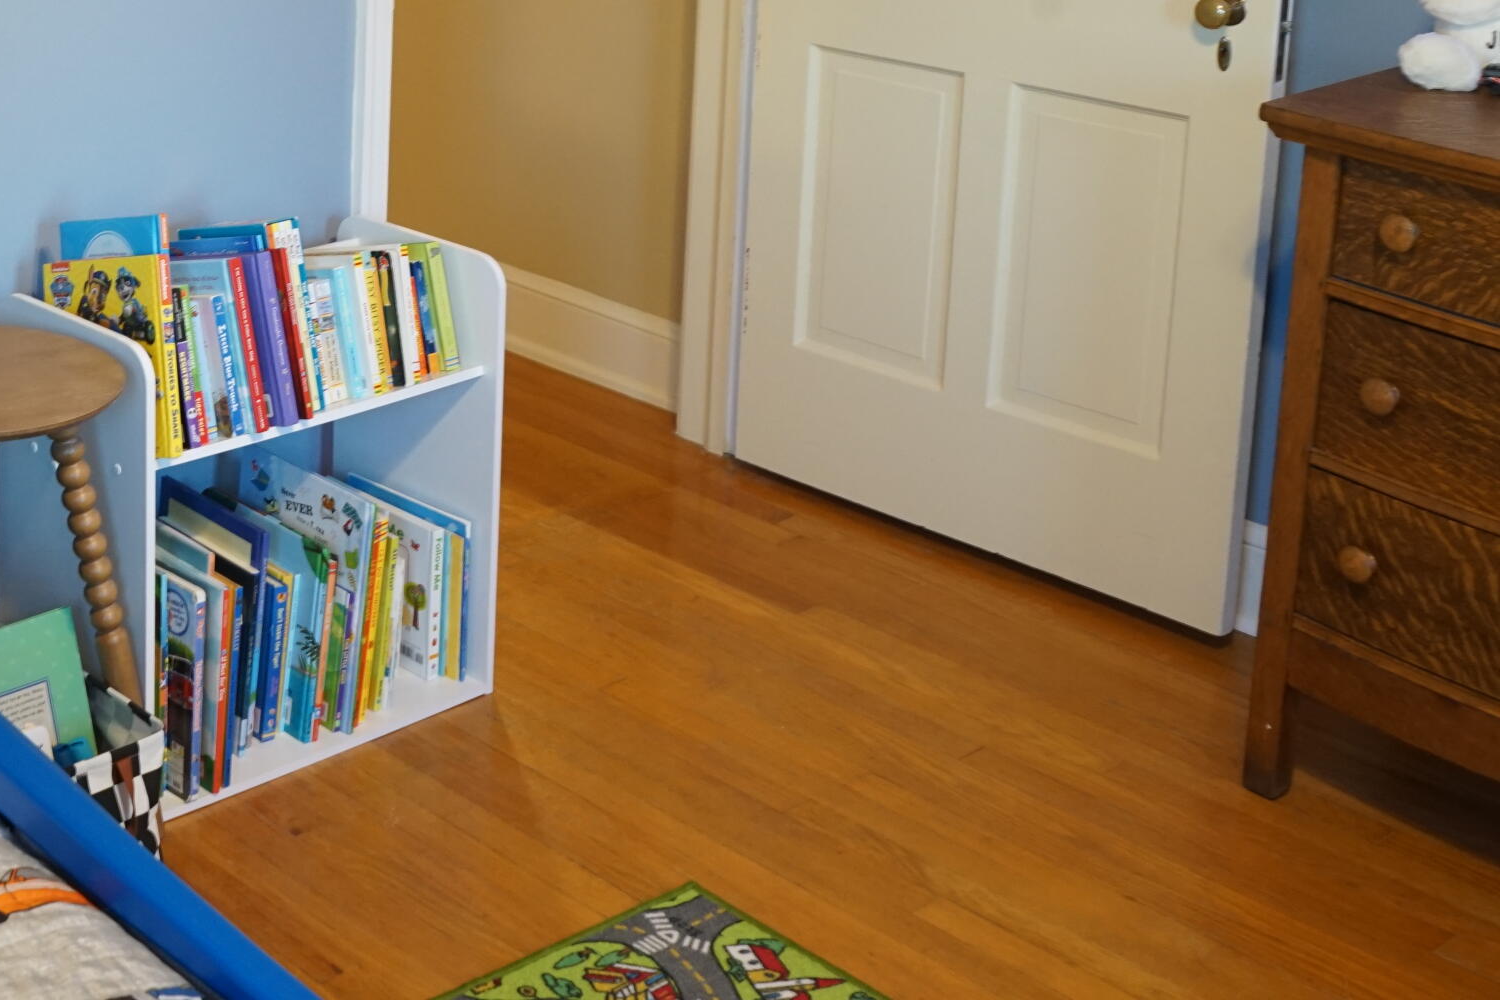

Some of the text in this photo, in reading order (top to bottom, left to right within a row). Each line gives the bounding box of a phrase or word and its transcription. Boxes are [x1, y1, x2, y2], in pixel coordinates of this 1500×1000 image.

[217, 323, 239, 412] Little Blue Truck
[374, 336, 386, 376] SPIDER
[285, 499, 314, 516] EVER
[434, 537, 443, 591] Follow Me
